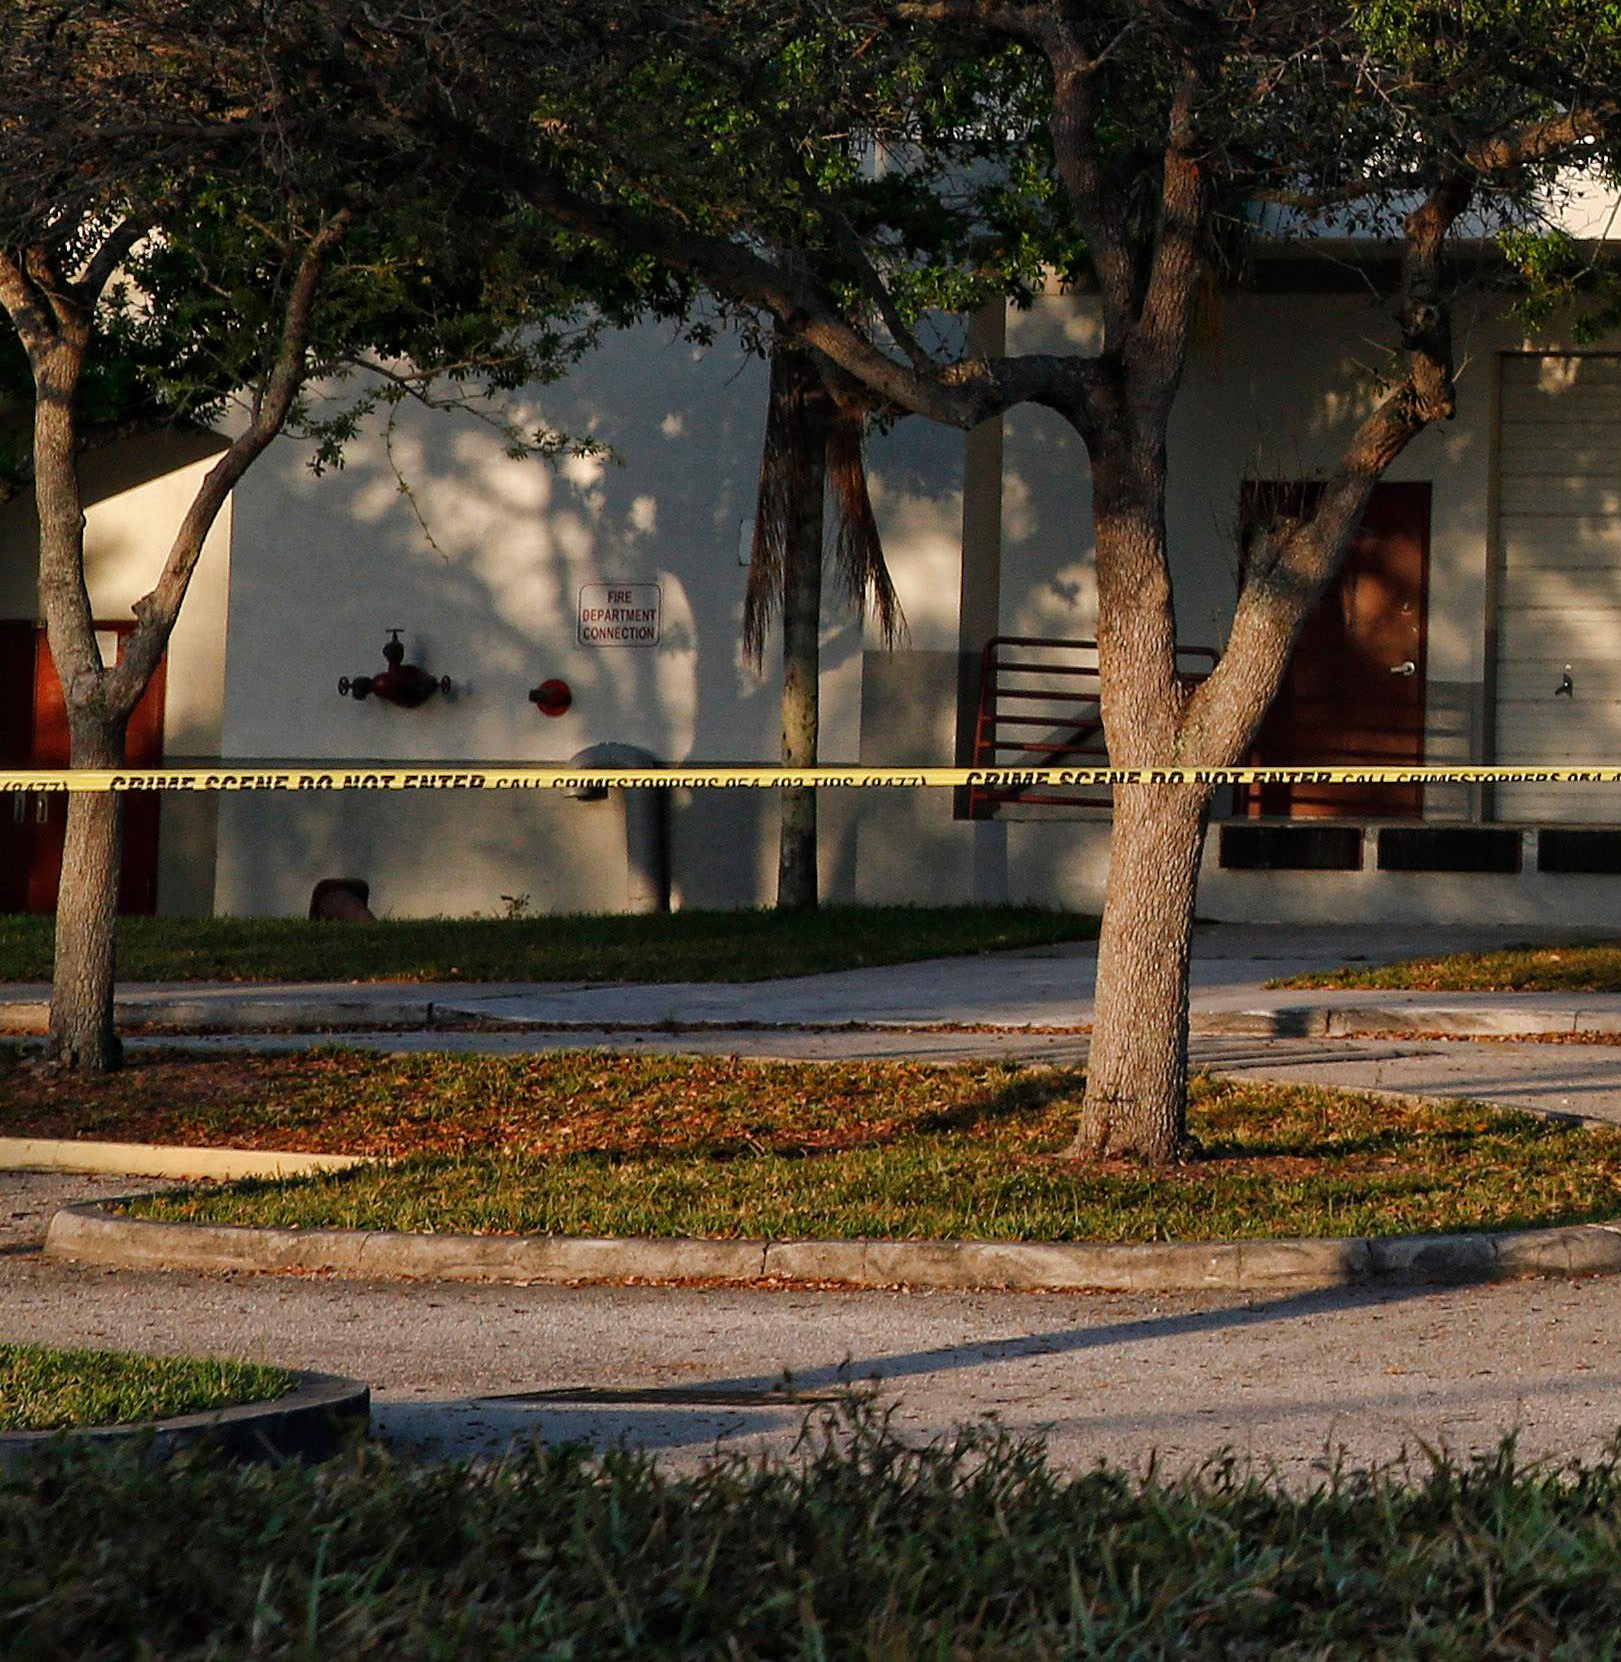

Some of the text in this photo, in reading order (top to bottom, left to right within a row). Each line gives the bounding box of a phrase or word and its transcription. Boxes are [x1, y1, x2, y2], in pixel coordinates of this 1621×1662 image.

[607, 590, 633, 604] FIRE
[582, 609, 657, 622] DEPARTMENT
[583, 626, 655, 640] CONNECTION
